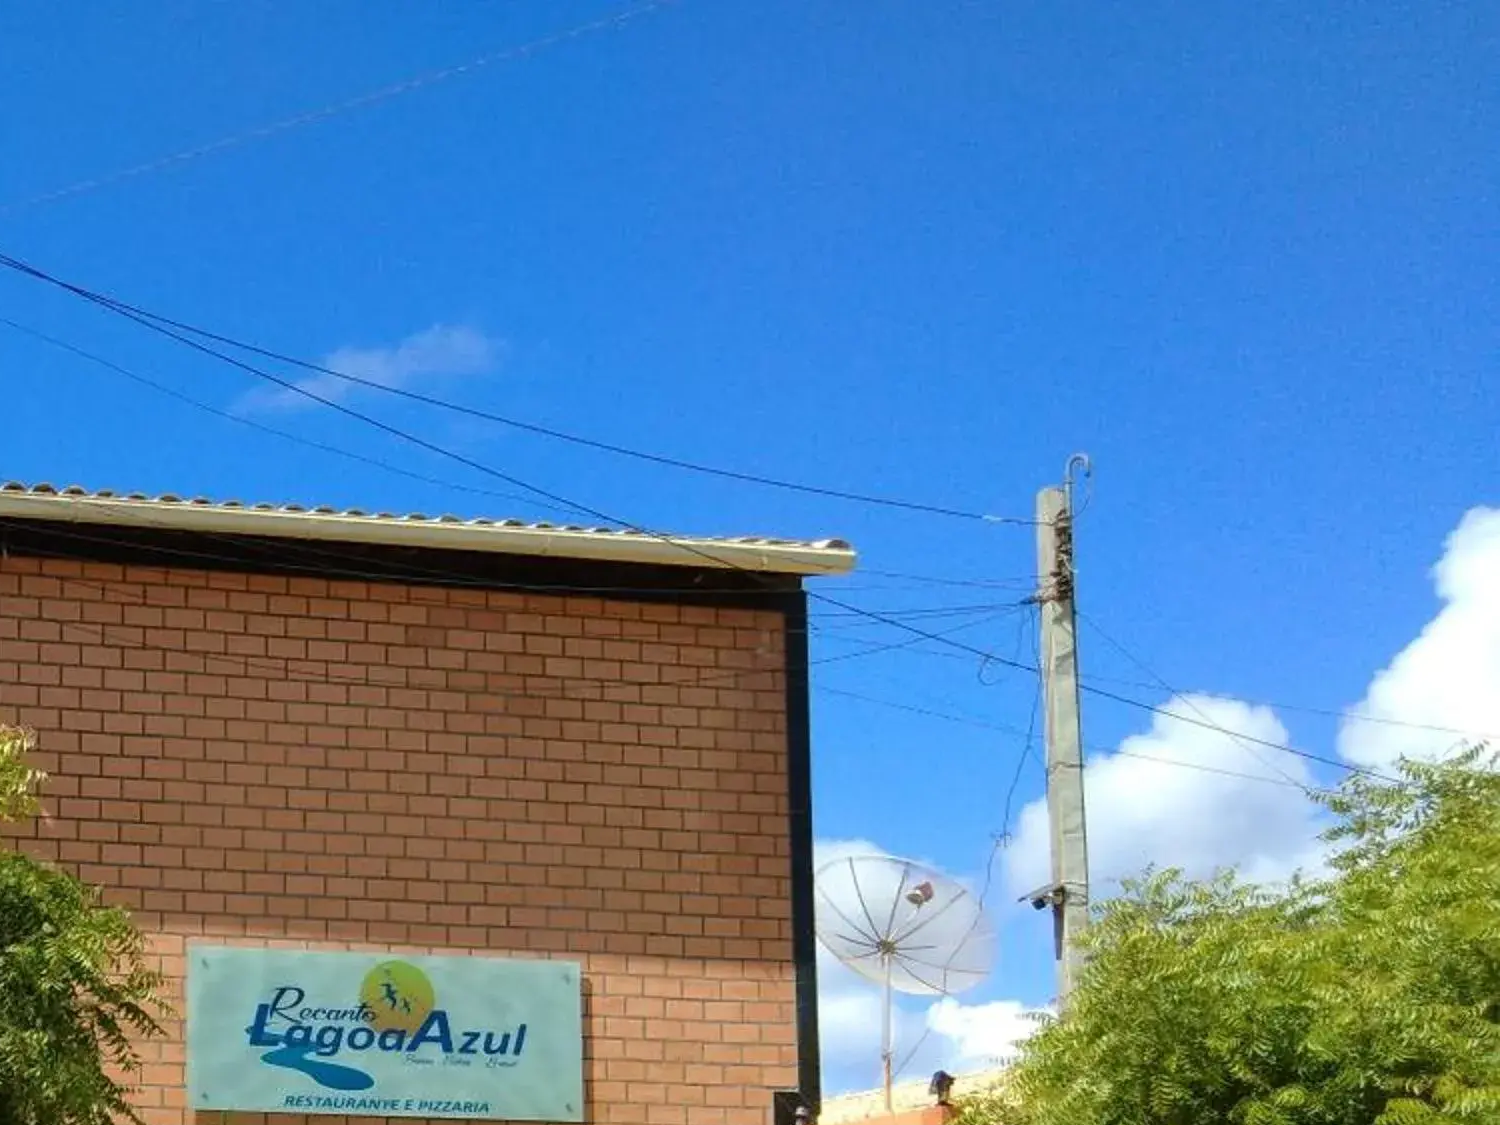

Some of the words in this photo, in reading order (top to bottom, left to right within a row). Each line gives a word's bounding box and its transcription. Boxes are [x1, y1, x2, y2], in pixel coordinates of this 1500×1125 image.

[269, 986, 377, 1023] Recanto
[284, 1095, 400, 1111] RESTAURANTE
[404, 1100, 415, 1111] E
[418, 1101, 489, 1113] PIZZARIA
